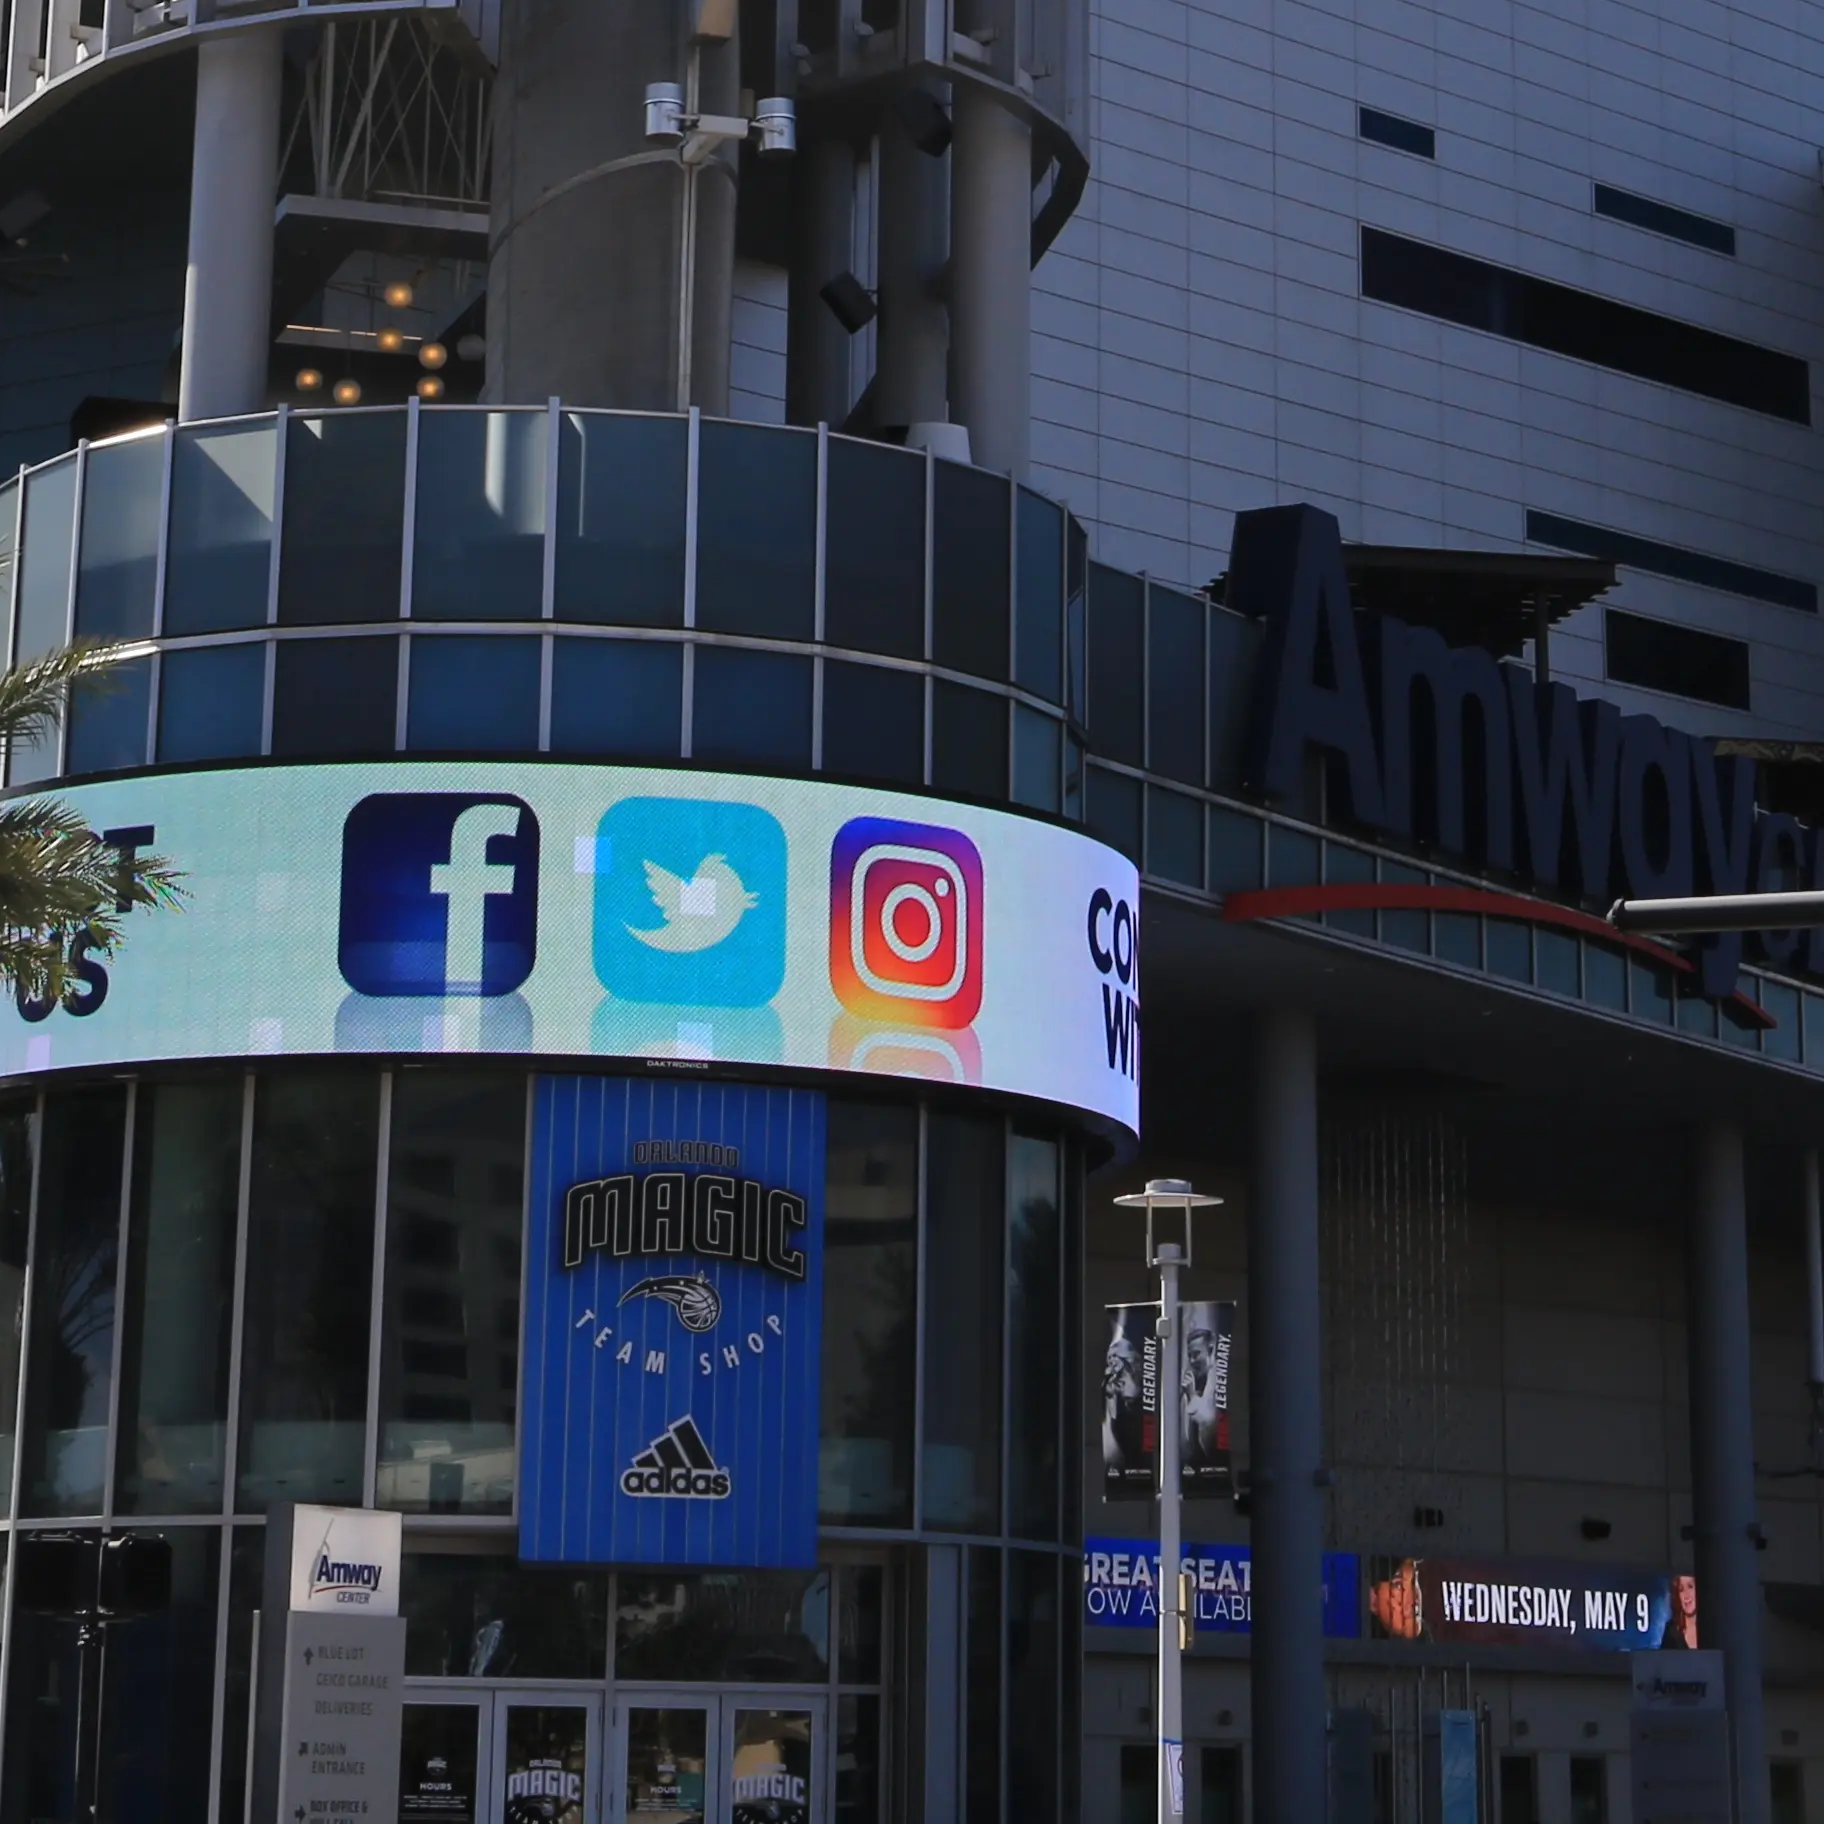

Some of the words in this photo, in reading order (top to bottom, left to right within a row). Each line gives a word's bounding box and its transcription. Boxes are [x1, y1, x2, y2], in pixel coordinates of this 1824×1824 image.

[1233, 502, 1755, 998] Amway
[646, 1059, 709, 1069] DAKTRONICS
[633, 1139, 740, 1168] ORLANDO
[564, 1172, 807, 1278] MAGIC
[575, 1308, 665, 1375] TEAM
[698, 1313, 785, 1376] SHOP
[1142, 1335, 1158, 1413] LEGENDARY.
[1214, 1333, 1233, 1410] LEGENDARY.
[622, 1465, 731, 1498] adidas
[317, 1555, 382, 1592] Amway
[336, 1591, 371, 1605] CENTER
[1441, 1580, 1576, 1635] WEDNESDAY,
[1584, 1589, 1629, 1633] MAY
[1636, 1593, 1650, 1634] 9
[318, 1646, 342, 1661] BLUE
[345, 1647, 365, 1661] LOT
[347, 1674, 389, 1689] GARAGE
[314, 1700, 374, 1717] DELIVERIES
[312, 1742, 347, 1756] ADMIN
[311, 1761, 366, 1776] ENTRANCE
[419, 1782, 453, 1792] HOURS
[507, 1769, 582, 1803] MAGIC
[734, 1774, 806, 1805] MAGIC
